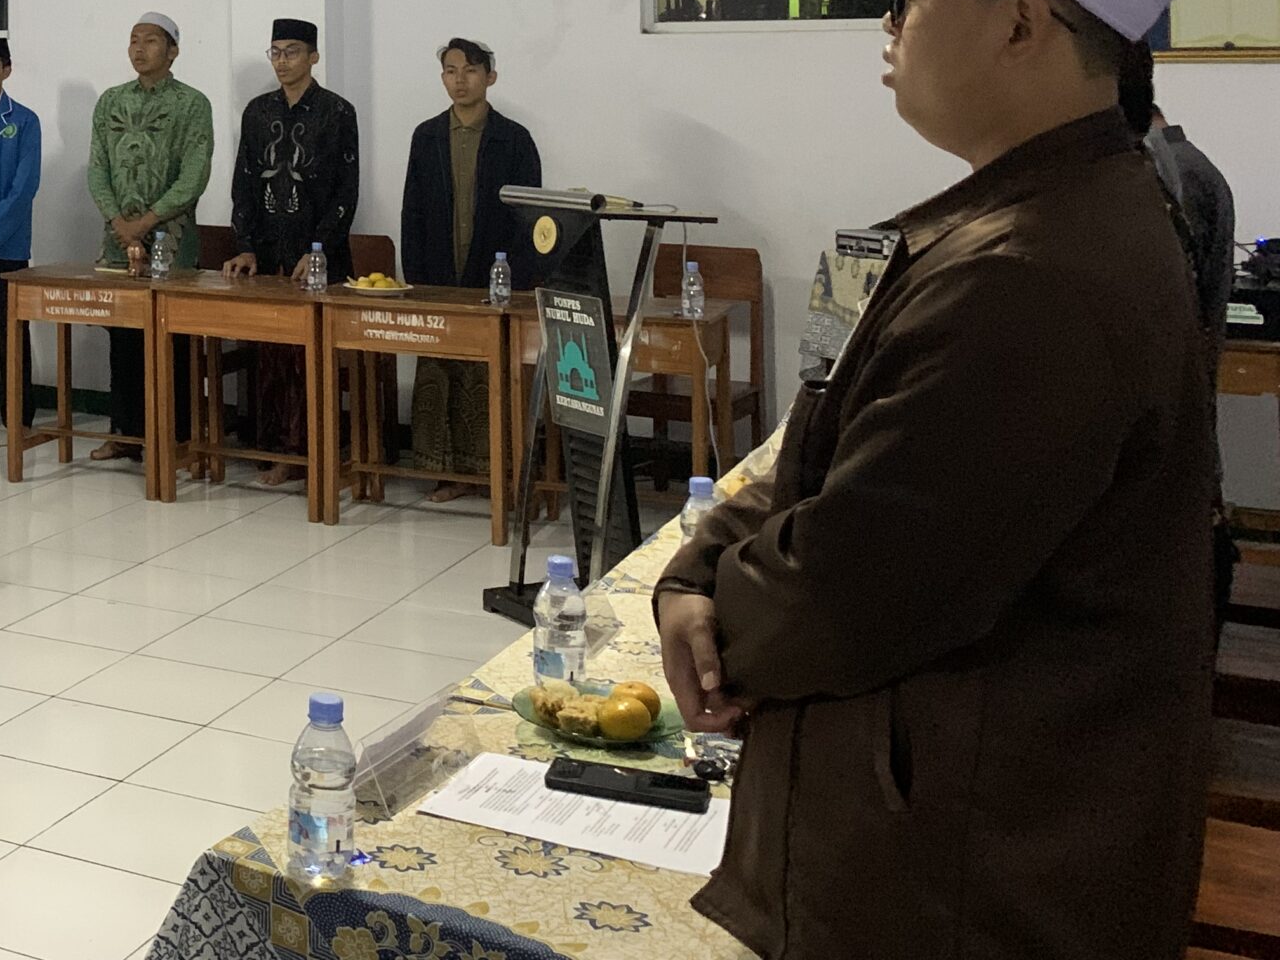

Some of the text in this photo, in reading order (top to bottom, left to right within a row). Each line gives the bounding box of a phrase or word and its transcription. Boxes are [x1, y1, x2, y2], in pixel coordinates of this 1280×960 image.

[98, 290, 113, 303] 522
[553, 296, 581, 311] PONPES
[361, 309, 395, 325] NURUL
[426, 315, 445, 330] 522
[572, 311, 596, 327] HUDA
